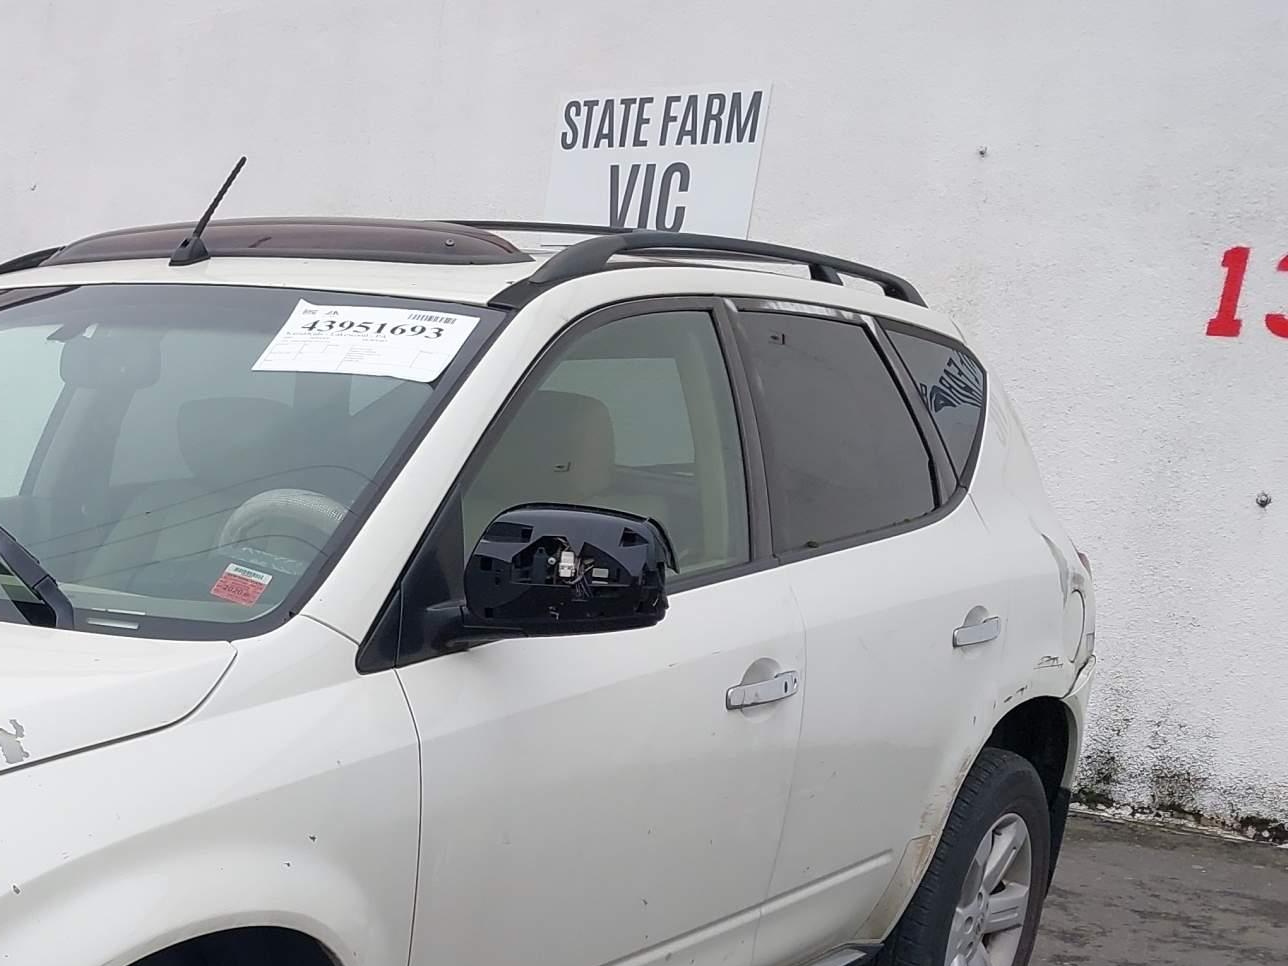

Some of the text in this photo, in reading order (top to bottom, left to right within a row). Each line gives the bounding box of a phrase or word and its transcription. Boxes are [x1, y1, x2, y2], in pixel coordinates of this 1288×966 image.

[561, 91, 763, 150] STATE FARM
[609, 161, 690, 233] VIC
[301, 318, 445, 340] 43951693
